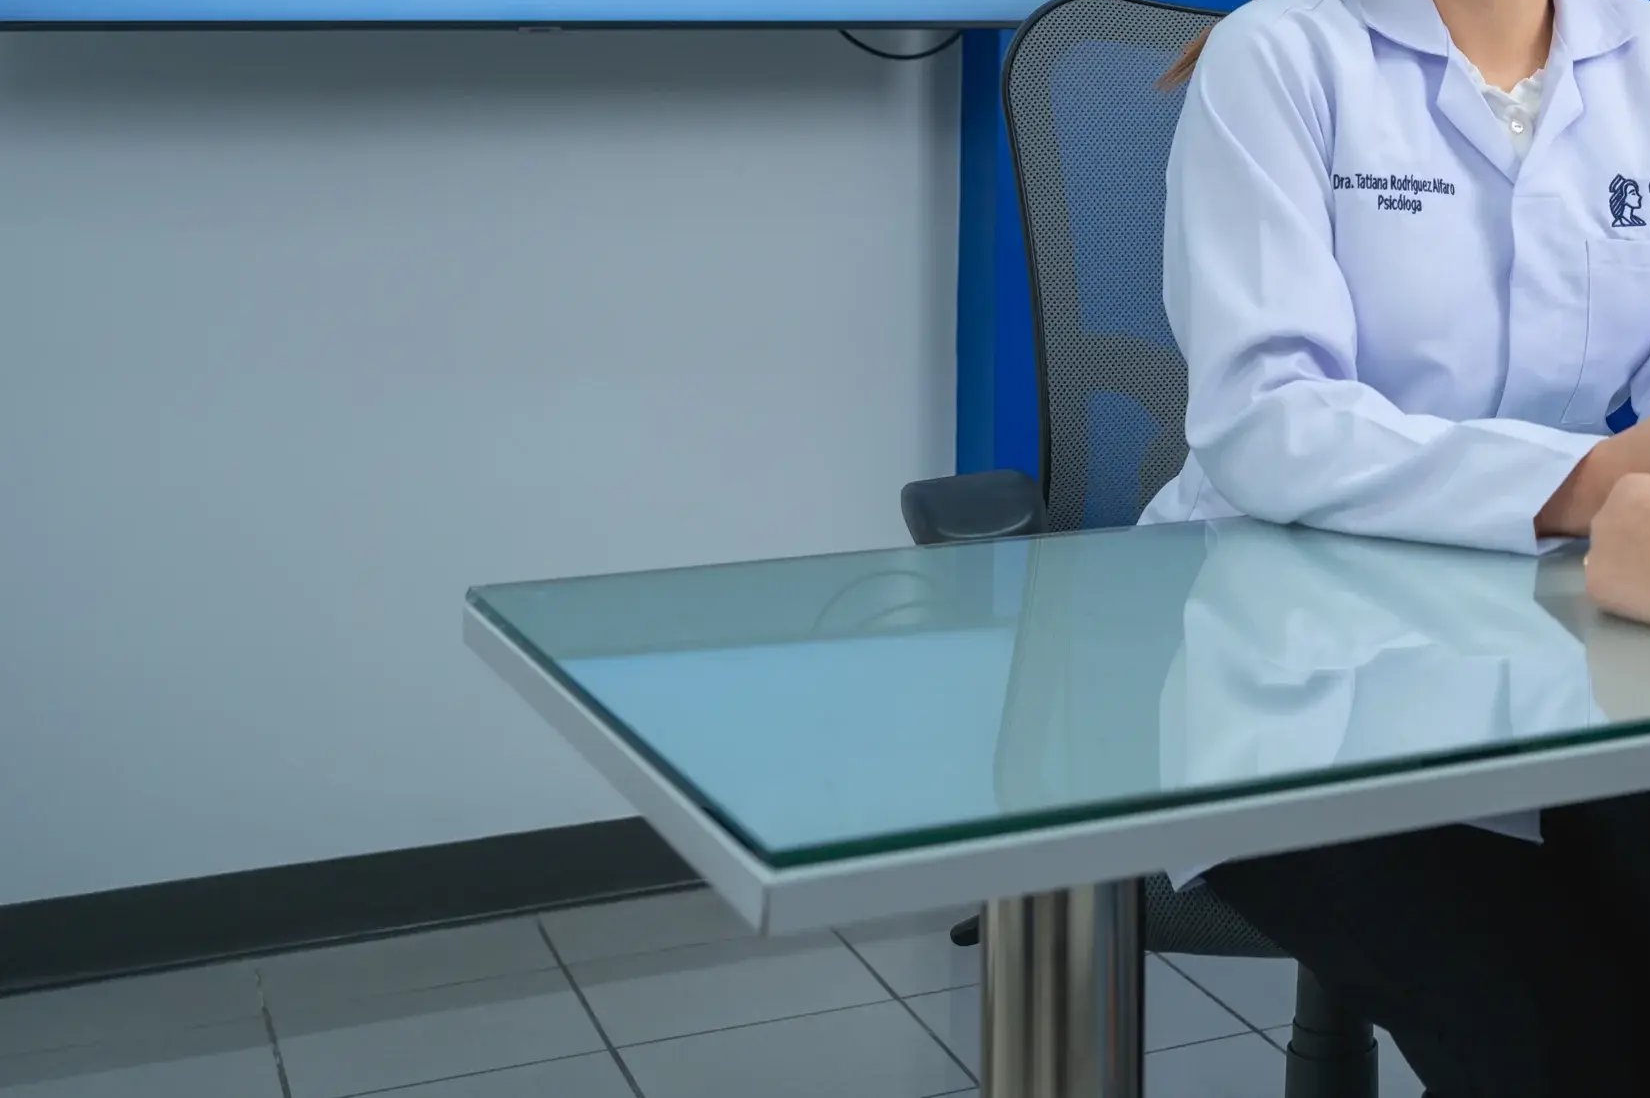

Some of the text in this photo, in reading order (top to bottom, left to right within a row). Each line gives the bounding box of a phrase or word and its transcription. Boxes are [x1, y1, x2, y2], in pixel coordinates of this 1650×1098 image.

[1333, 173, 1455, 196] Dra. Tatiana Rodríguez Alfaro
[1377, 194, 1423, 214] Psicóloga
